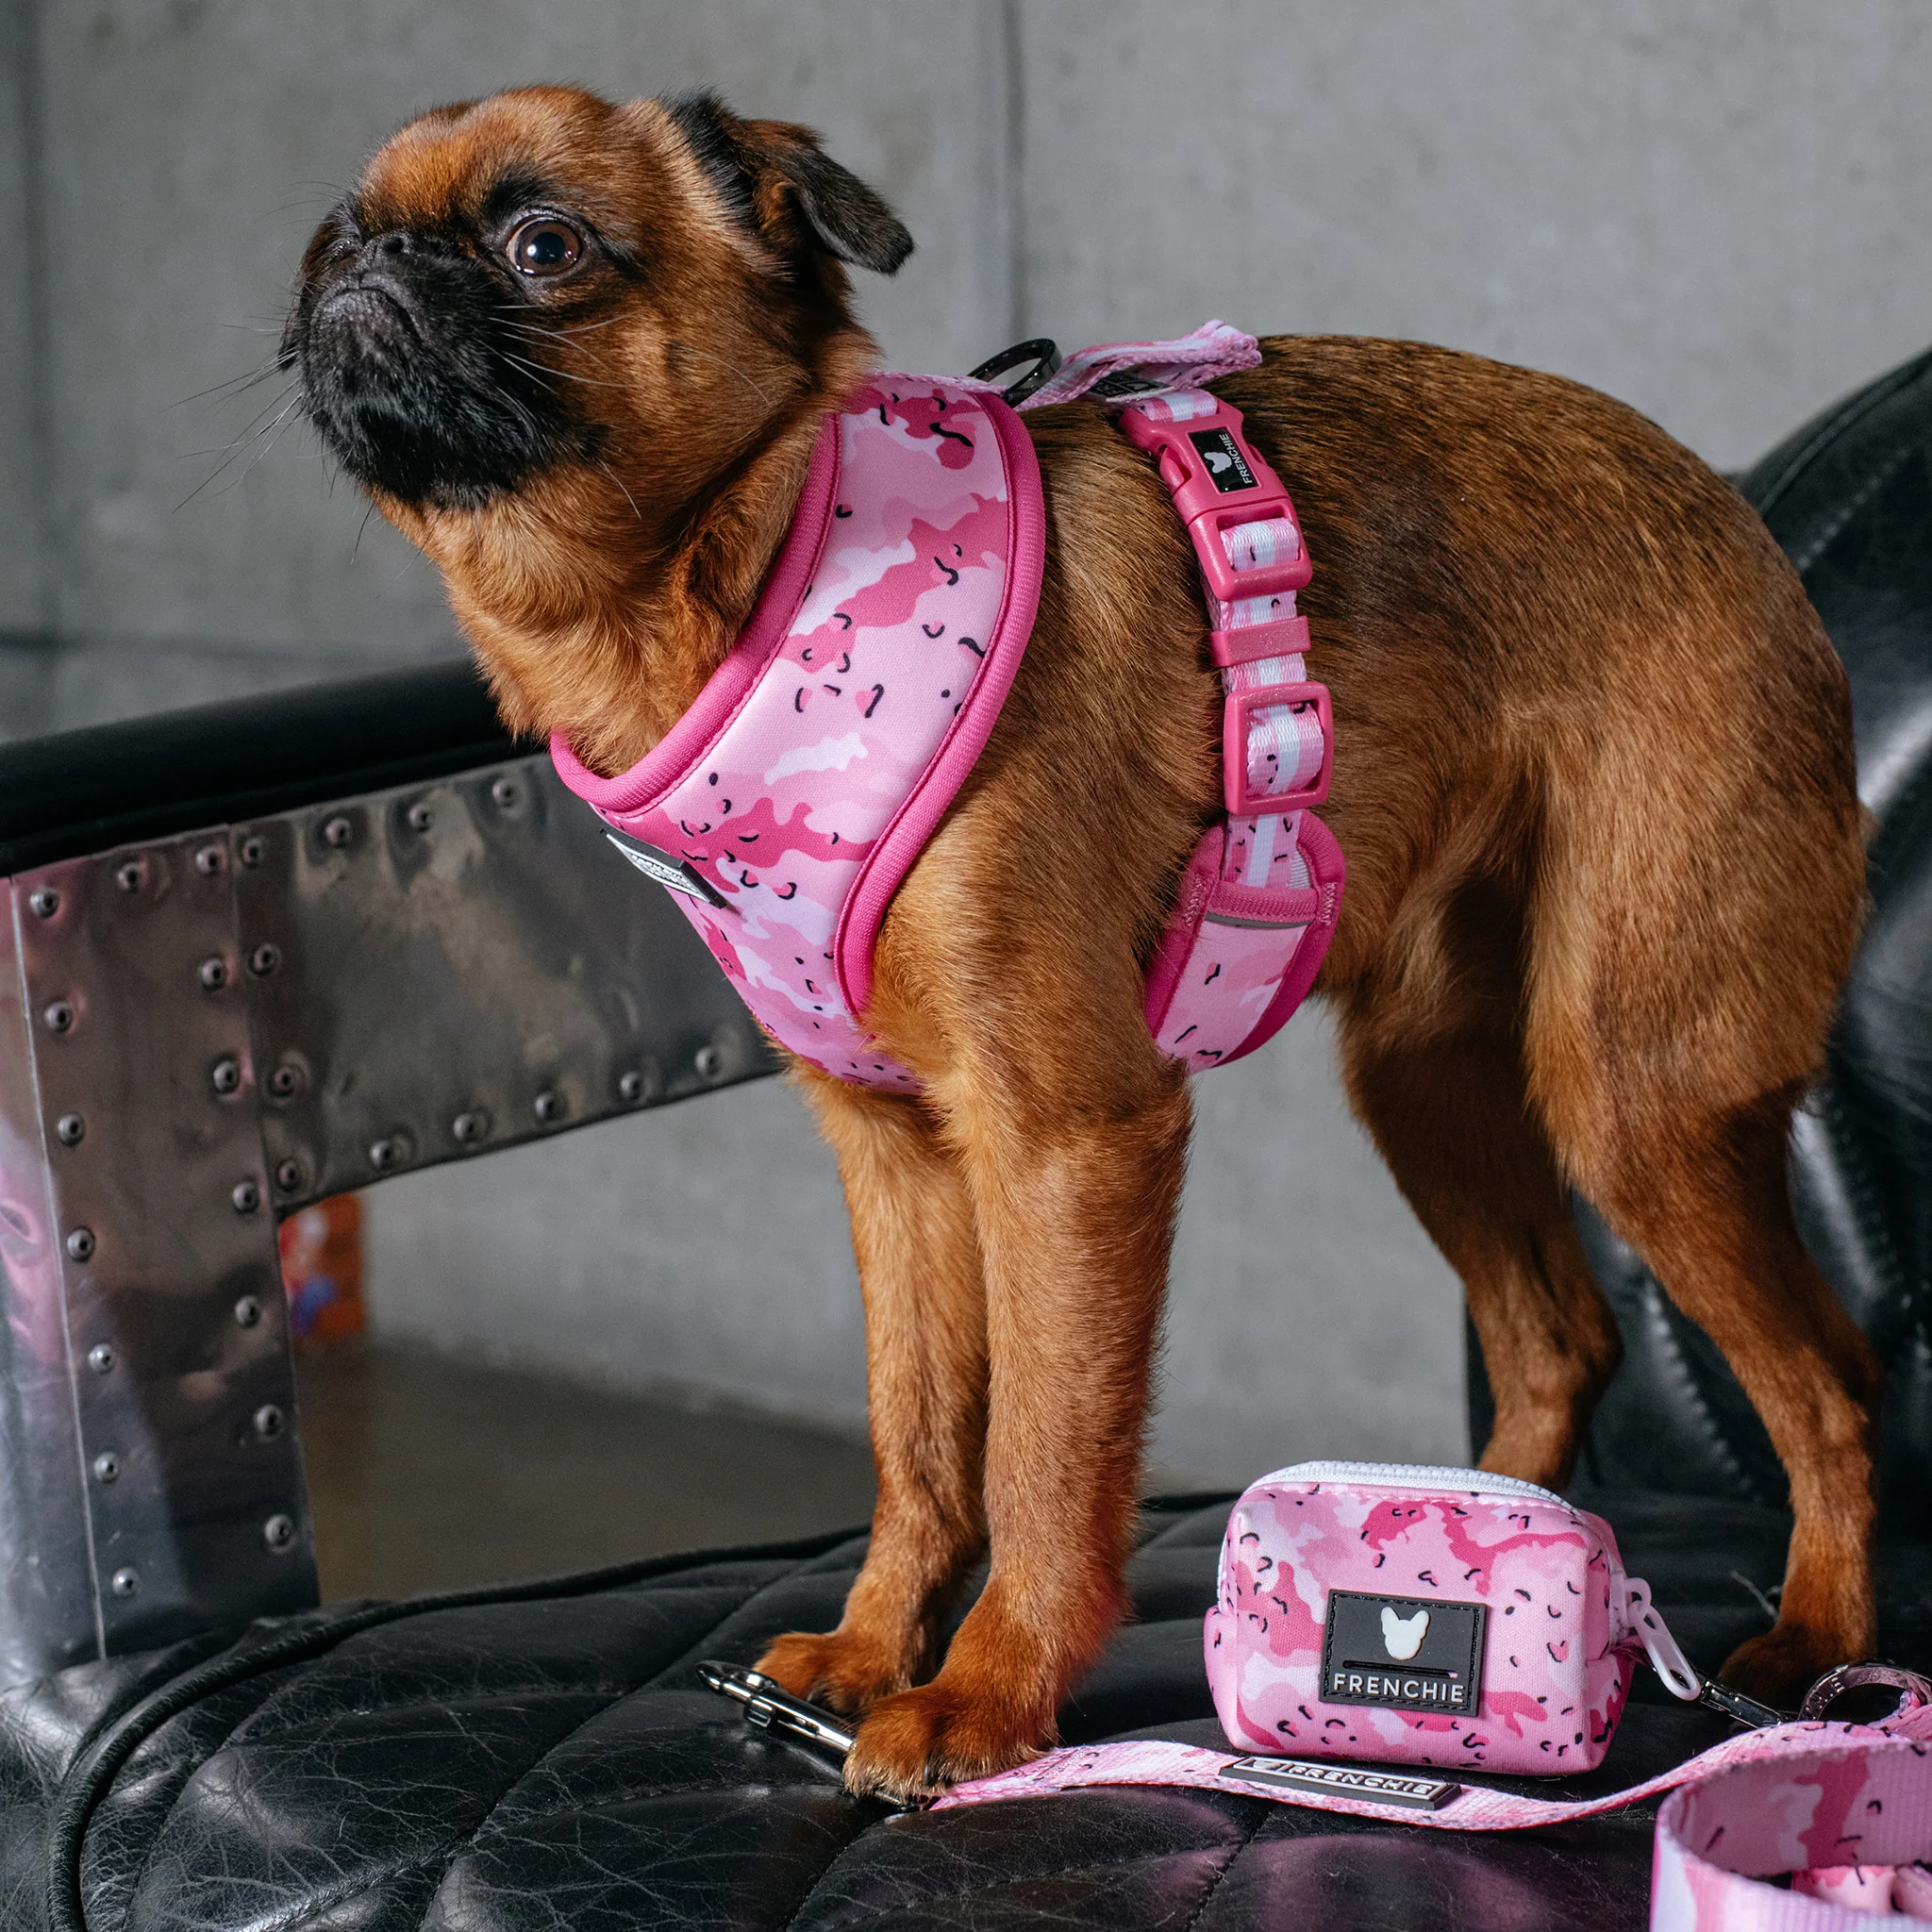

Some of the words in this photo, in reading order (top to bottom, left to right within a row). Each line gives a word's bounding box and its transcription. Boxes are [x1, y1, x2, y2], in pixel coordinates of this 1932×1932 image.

[1219, 433, 1253, 484] FRENCHIE
[1333, 1673, 1464, 1703] FRENCHIE
[1289, 1765, 1433, 1793] FRENCHIE
